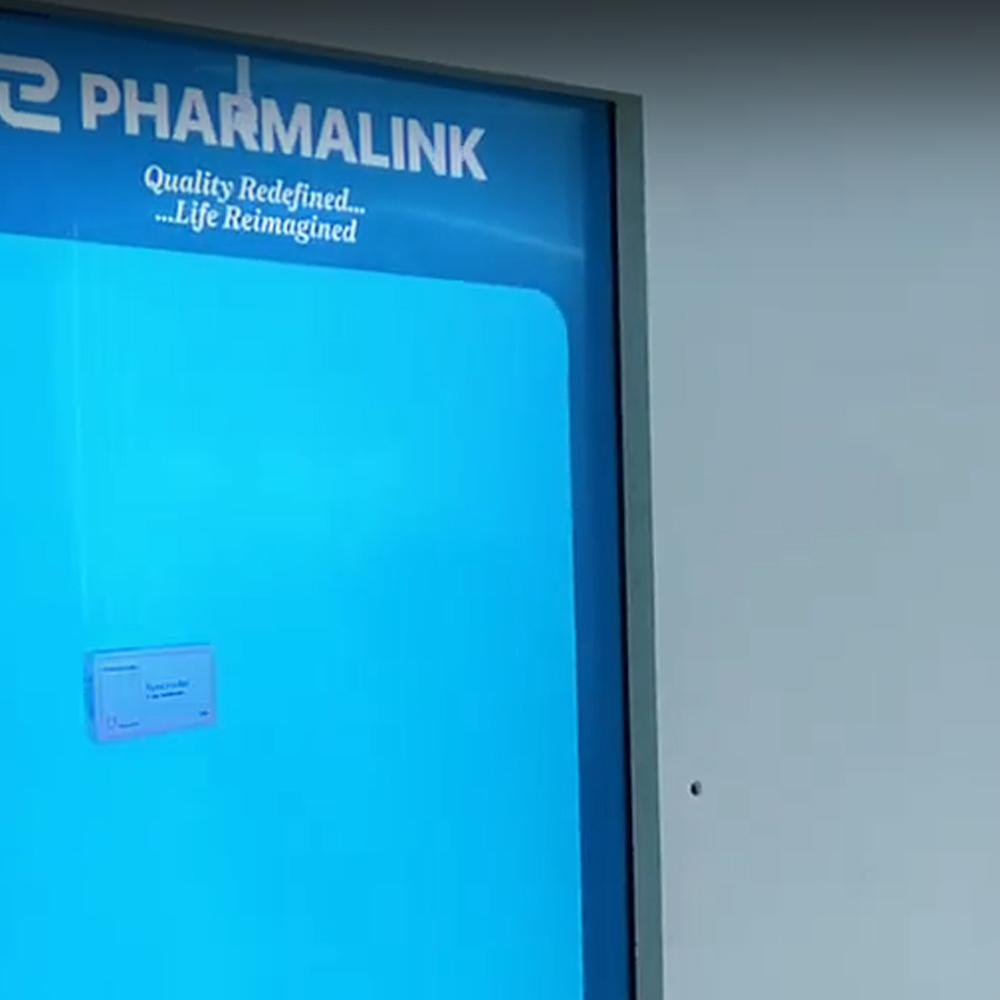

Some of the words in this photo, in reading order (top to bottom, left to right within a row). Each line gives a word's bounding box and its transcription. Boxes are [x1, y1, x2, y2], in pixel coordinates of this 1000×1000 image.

[80, 72, 488, 182] PHARMALINK
[144, 164, 233, 203] Quality
[238, 176, 366, 213] Redefined...
[155, 199, 218, 232] ...Life
[222, 205, 357, 244] Reimagined
